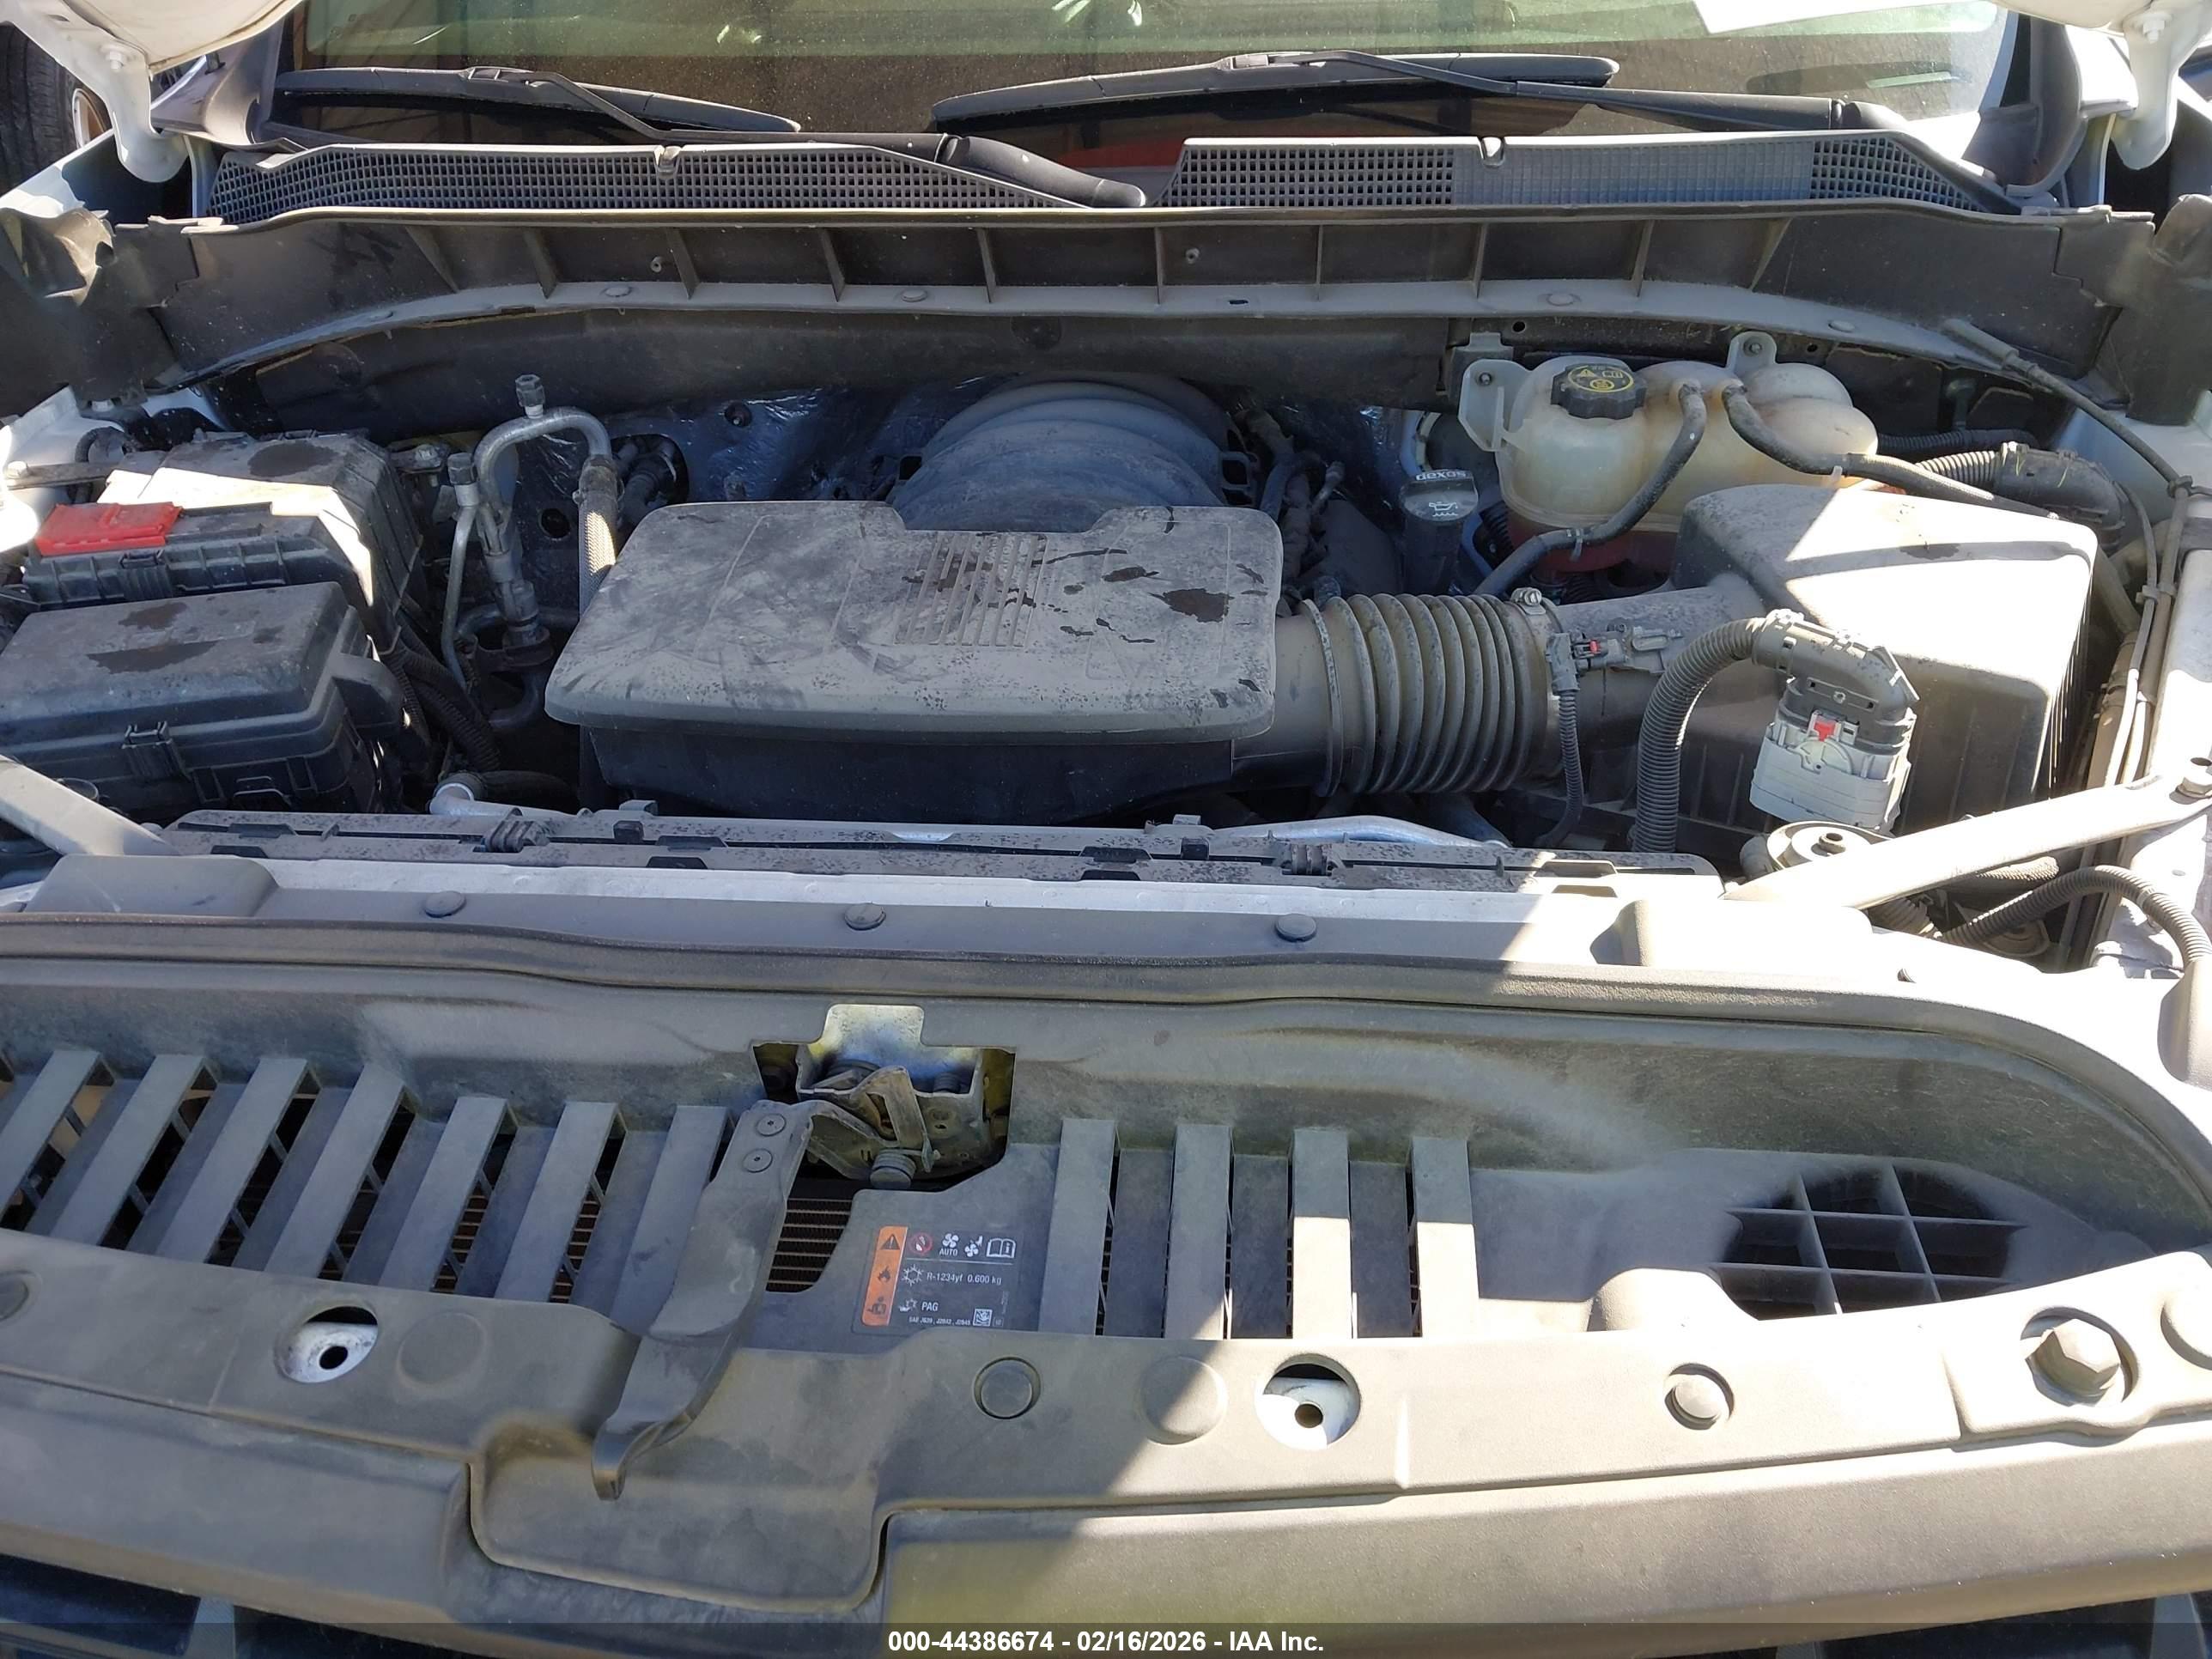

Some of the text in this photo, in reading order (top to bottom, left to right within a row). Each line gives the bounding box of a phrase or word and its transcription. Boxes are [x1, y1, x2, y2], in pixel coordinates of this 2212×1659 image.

[1415, 471, 1467, 481] dexos
[939, 1248, 958, 1256] AUTO
[927, 1272, 1002, 1286] R-1234yf 0.600 kg
[921, 1302, 939, 1312] PAG
